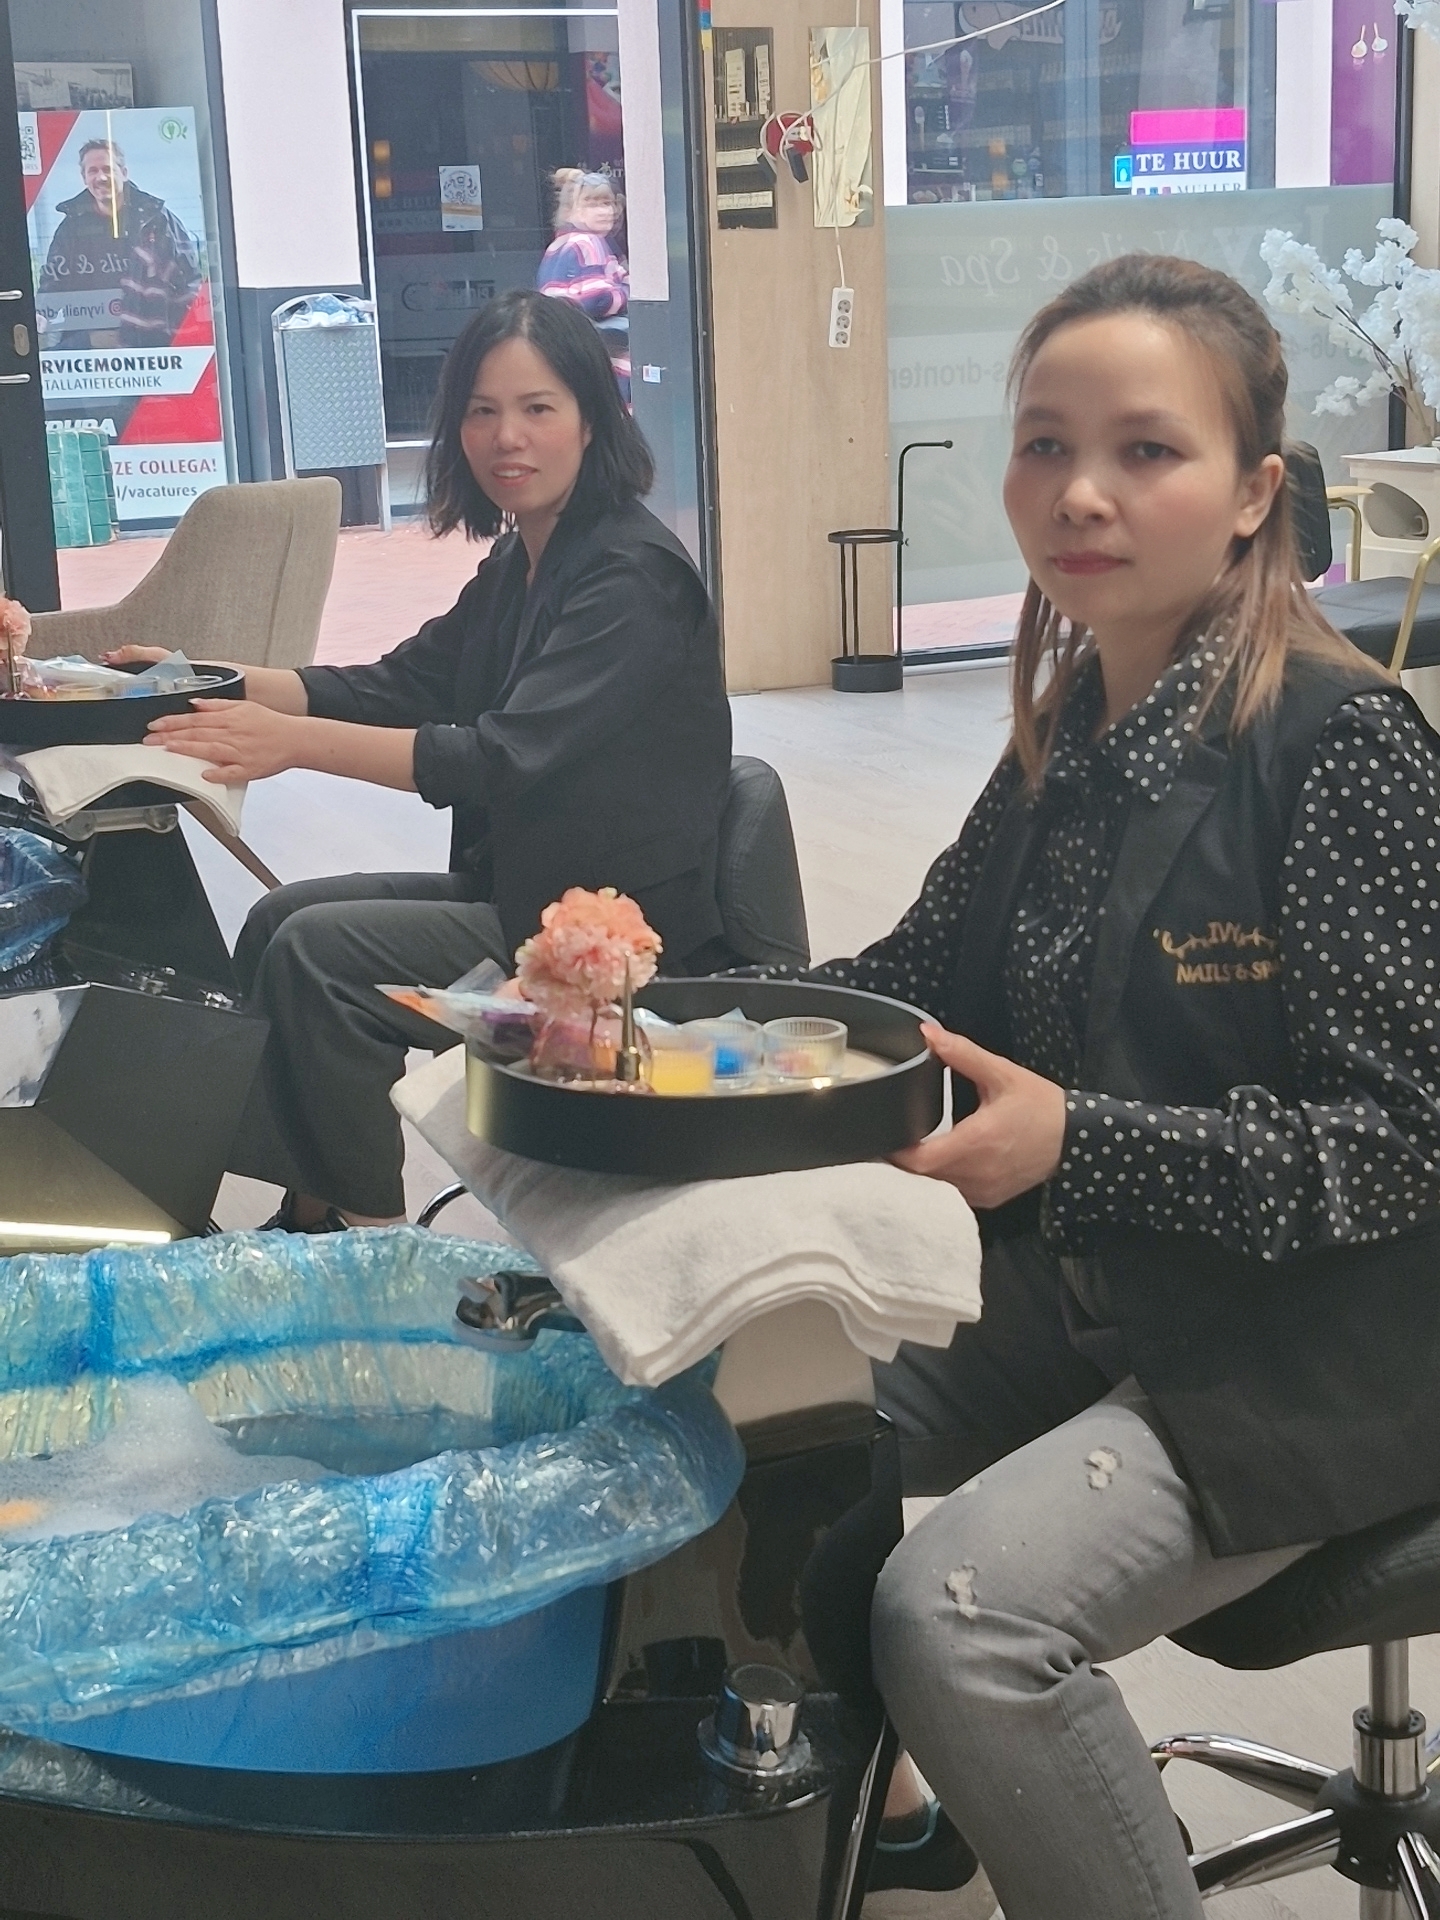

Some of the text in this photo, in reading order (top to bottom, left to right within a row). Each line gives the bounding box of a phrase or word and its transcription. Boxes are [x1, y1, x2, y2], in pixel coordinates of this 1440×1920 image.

[1136, 150, 1242, 172] TE HUUR
[41, 355, 183, 374] RVICEMONTEUR
[44, 375, 162, 391] TALLATIETECHNIEK
[114, 458, 218, 476] ZE COLLEGA!
[1176, 962, 1231, 985] NAILS
